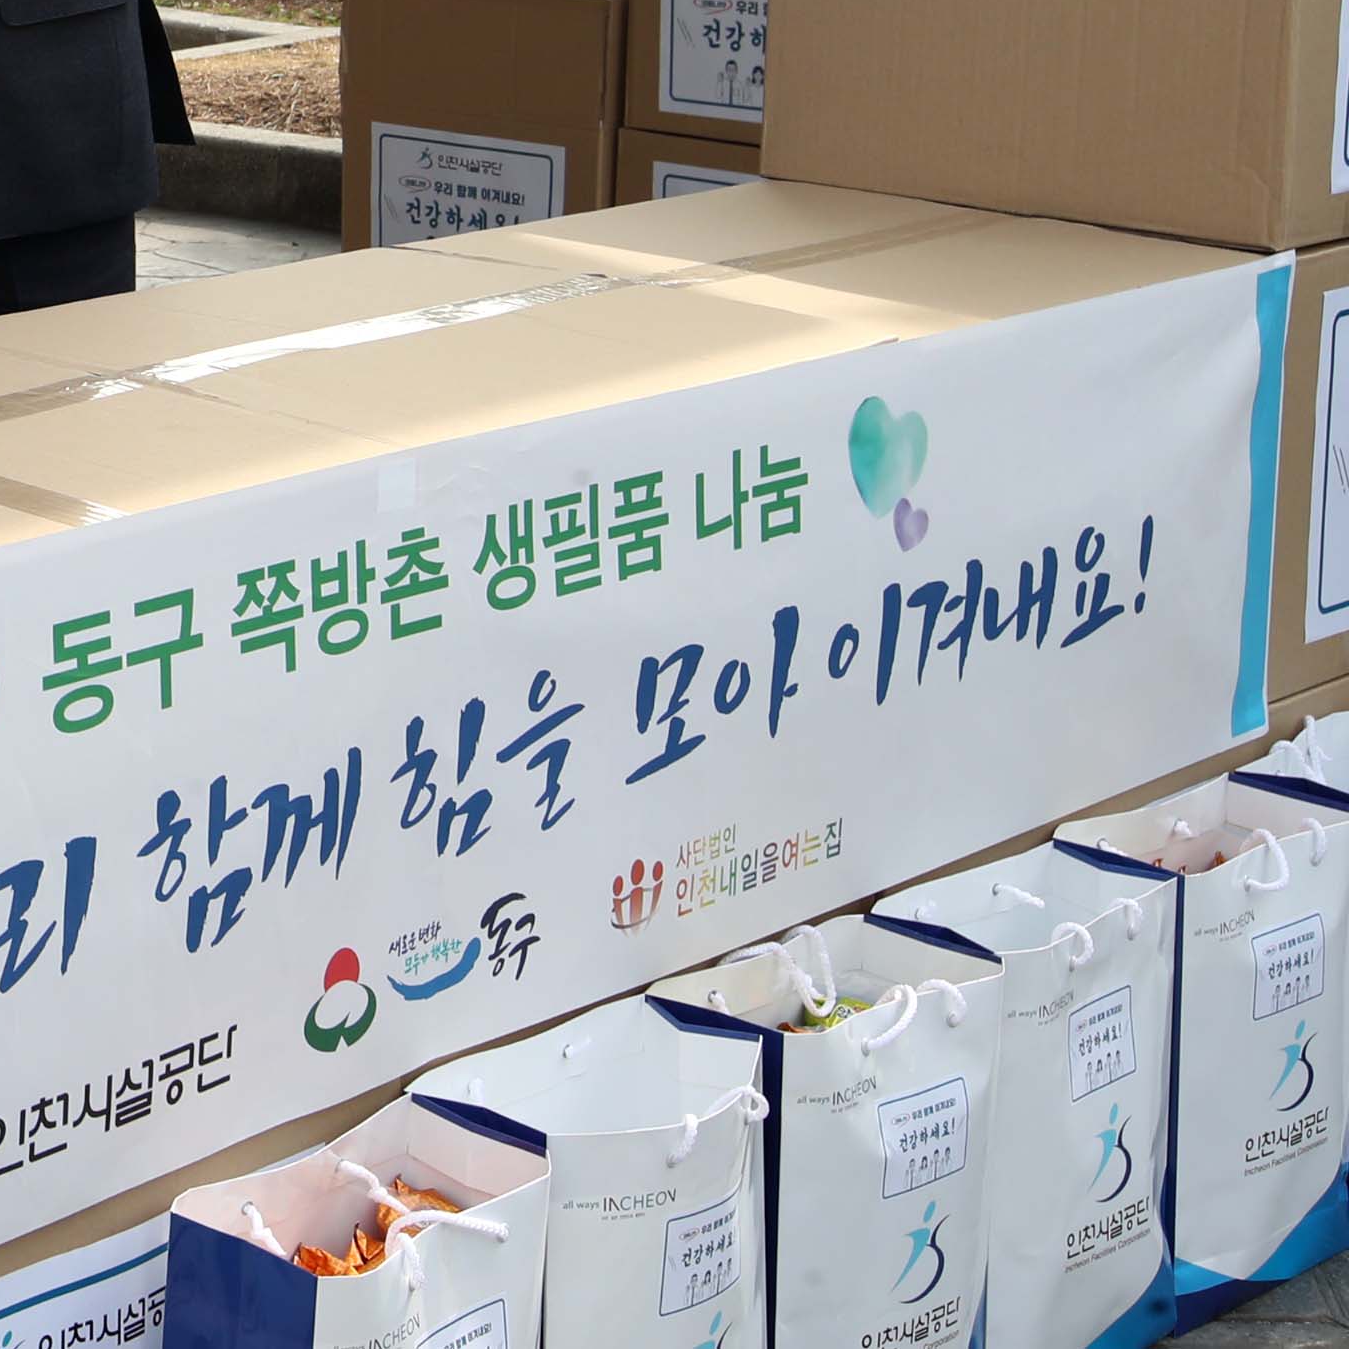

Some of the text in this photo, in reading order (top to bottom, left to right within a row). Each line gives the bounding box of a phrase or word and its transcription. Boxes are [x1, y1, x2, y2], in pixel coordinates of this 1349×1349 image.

[735, 1, 758, 15] 우리
[437, 155, 503, 176] 인천시설공단
[434, 181, 453, 196] 우리
[457, 185, 477, 199] 함께
[481, 188, 525, 206] 이겨내요!
[42, 444, 809, 733] 동구 쪽방촌 생필품 나눔
[137, 747, 363, 954] 함께
[389, 670, 586, 858] 힘을
[625, 606, 801, 784] 모아
[828, 515, 1154, 705] 이겨내요!
[675, 818, 843, 917] 인천내일을여는집
[676, 823, 737, 869] 사단법인
[480, 891, 541, 980] 동구
[797, 1075, 877, 1106] all ways INCHEON
[899, 1117, 955, 1153] 건강하세요!
[1245, 1106, 1329, 1162] 인천시설공단
[562, 1188, 677, 1212] all ways INCHEON
[1066, 1196, 1149, 1259] 인천시설공단
